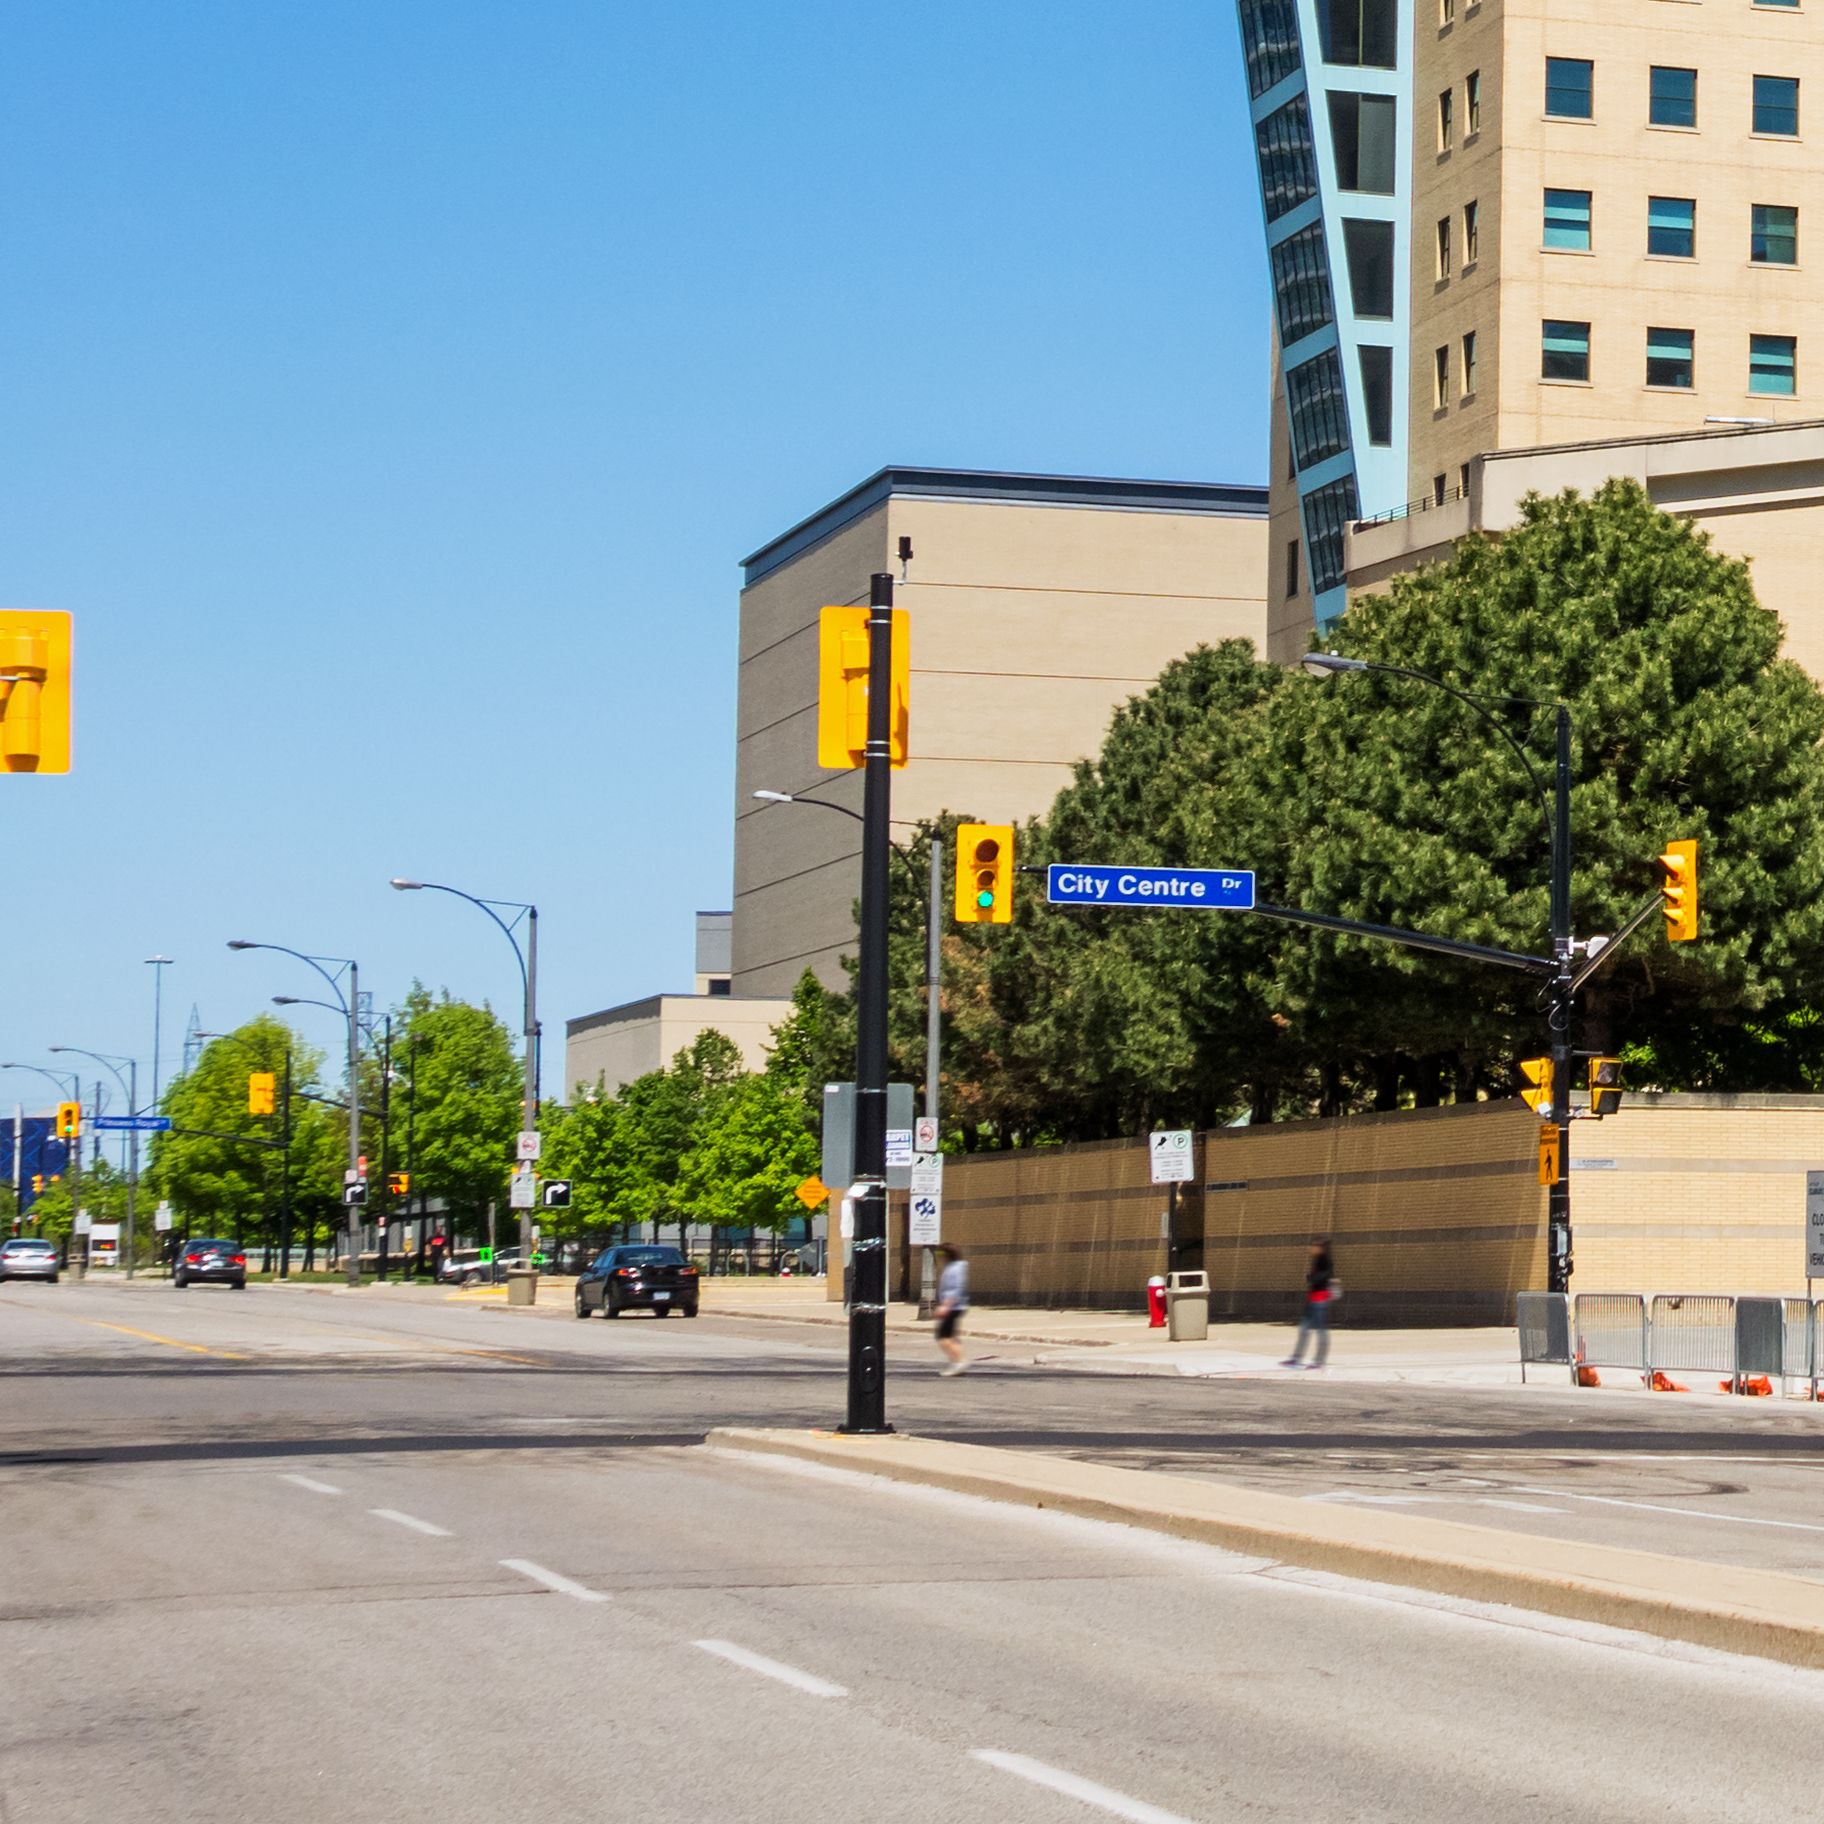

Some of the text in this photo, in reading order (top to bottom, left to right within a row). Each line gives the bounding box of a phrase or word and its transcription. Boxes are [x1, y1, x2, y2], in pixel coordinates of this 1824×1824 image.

[1057, 873, 1243, 899] City Centre Dr
